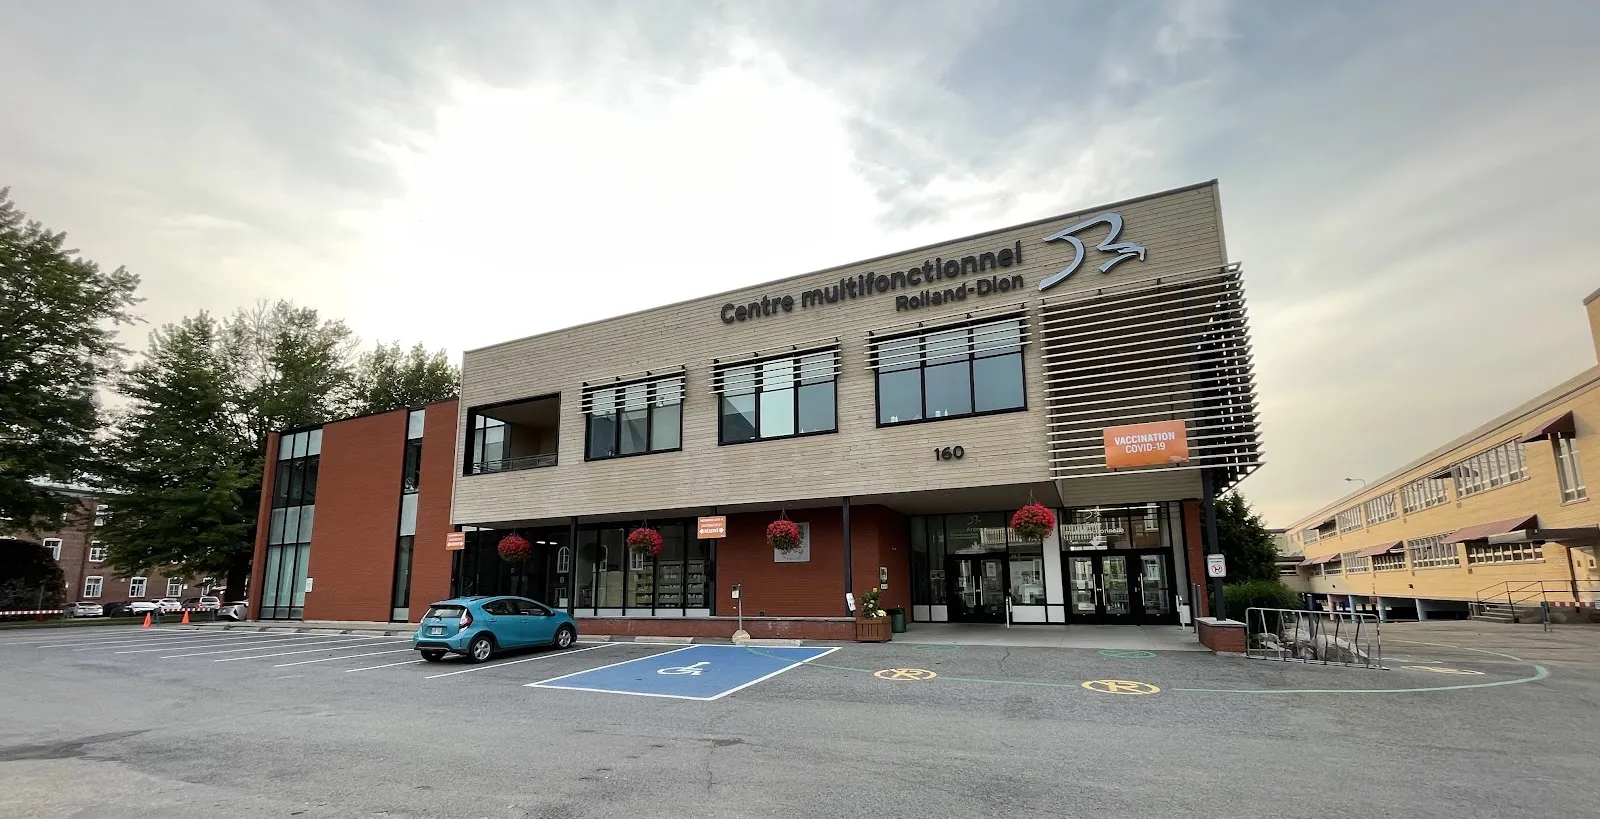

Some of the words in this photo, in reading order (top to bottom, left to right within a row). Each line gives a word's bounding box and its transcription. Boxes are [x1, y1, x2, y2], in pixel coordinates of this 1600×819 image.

[720, 294, 794, 324] Centre
[801, 239, 1023, 308] multifonctionnel
[895, 273, 1024, 312] Rolland-Dion
[1114, 431, 1176, 446] VACCINATION
[933, 445, 965, 461] 160
[1125, 441, 1166, 454] COVID-19
